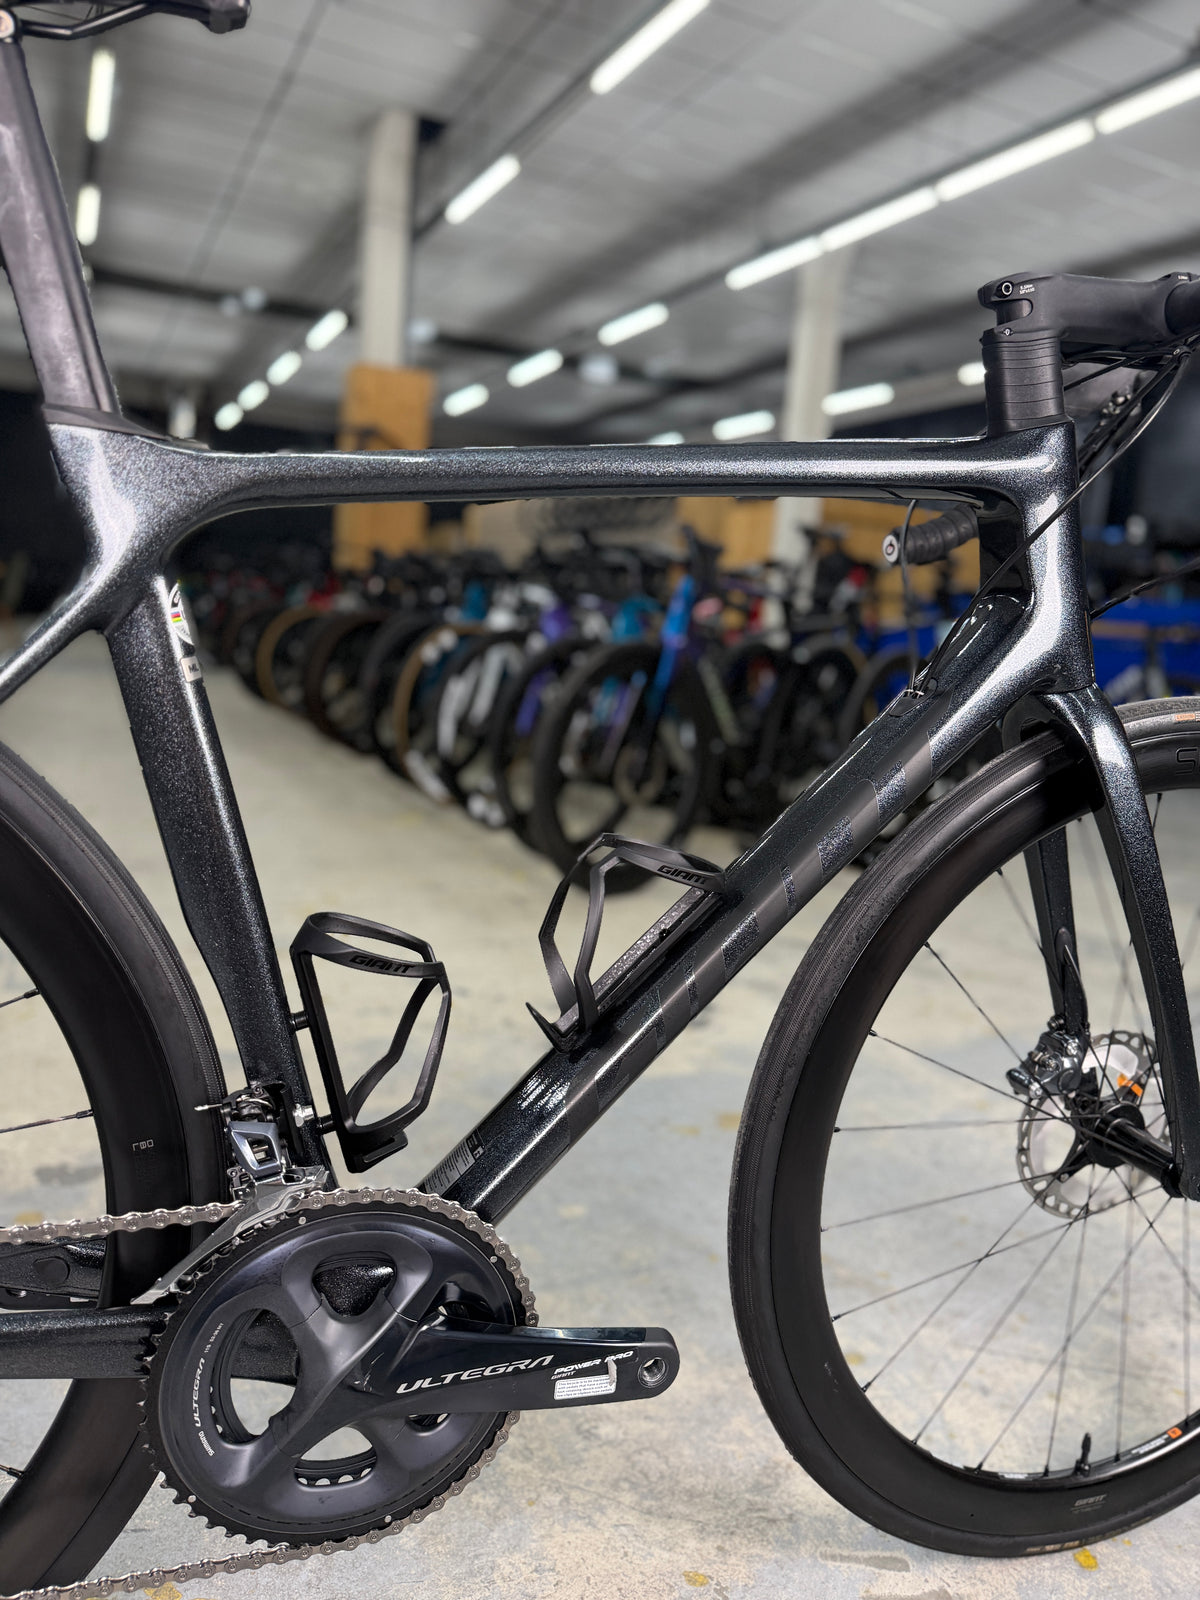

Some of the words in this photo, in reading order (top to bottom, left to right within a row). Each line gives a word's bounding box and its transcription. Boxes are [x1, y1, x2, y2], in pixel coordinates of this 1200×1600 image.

[188, 663, 200, 674] ML
[349, 955, 416, 974] GIANT
[396, 1354, 555, 1394] ULTEGRA
[554, 1359, 601, 1374] POWER
[604, 1351, 634, 1362] PRO
[193, 1358, 205, 1427] ULTEGRA
[199, 1431, 215, 1456] SHIMANO
